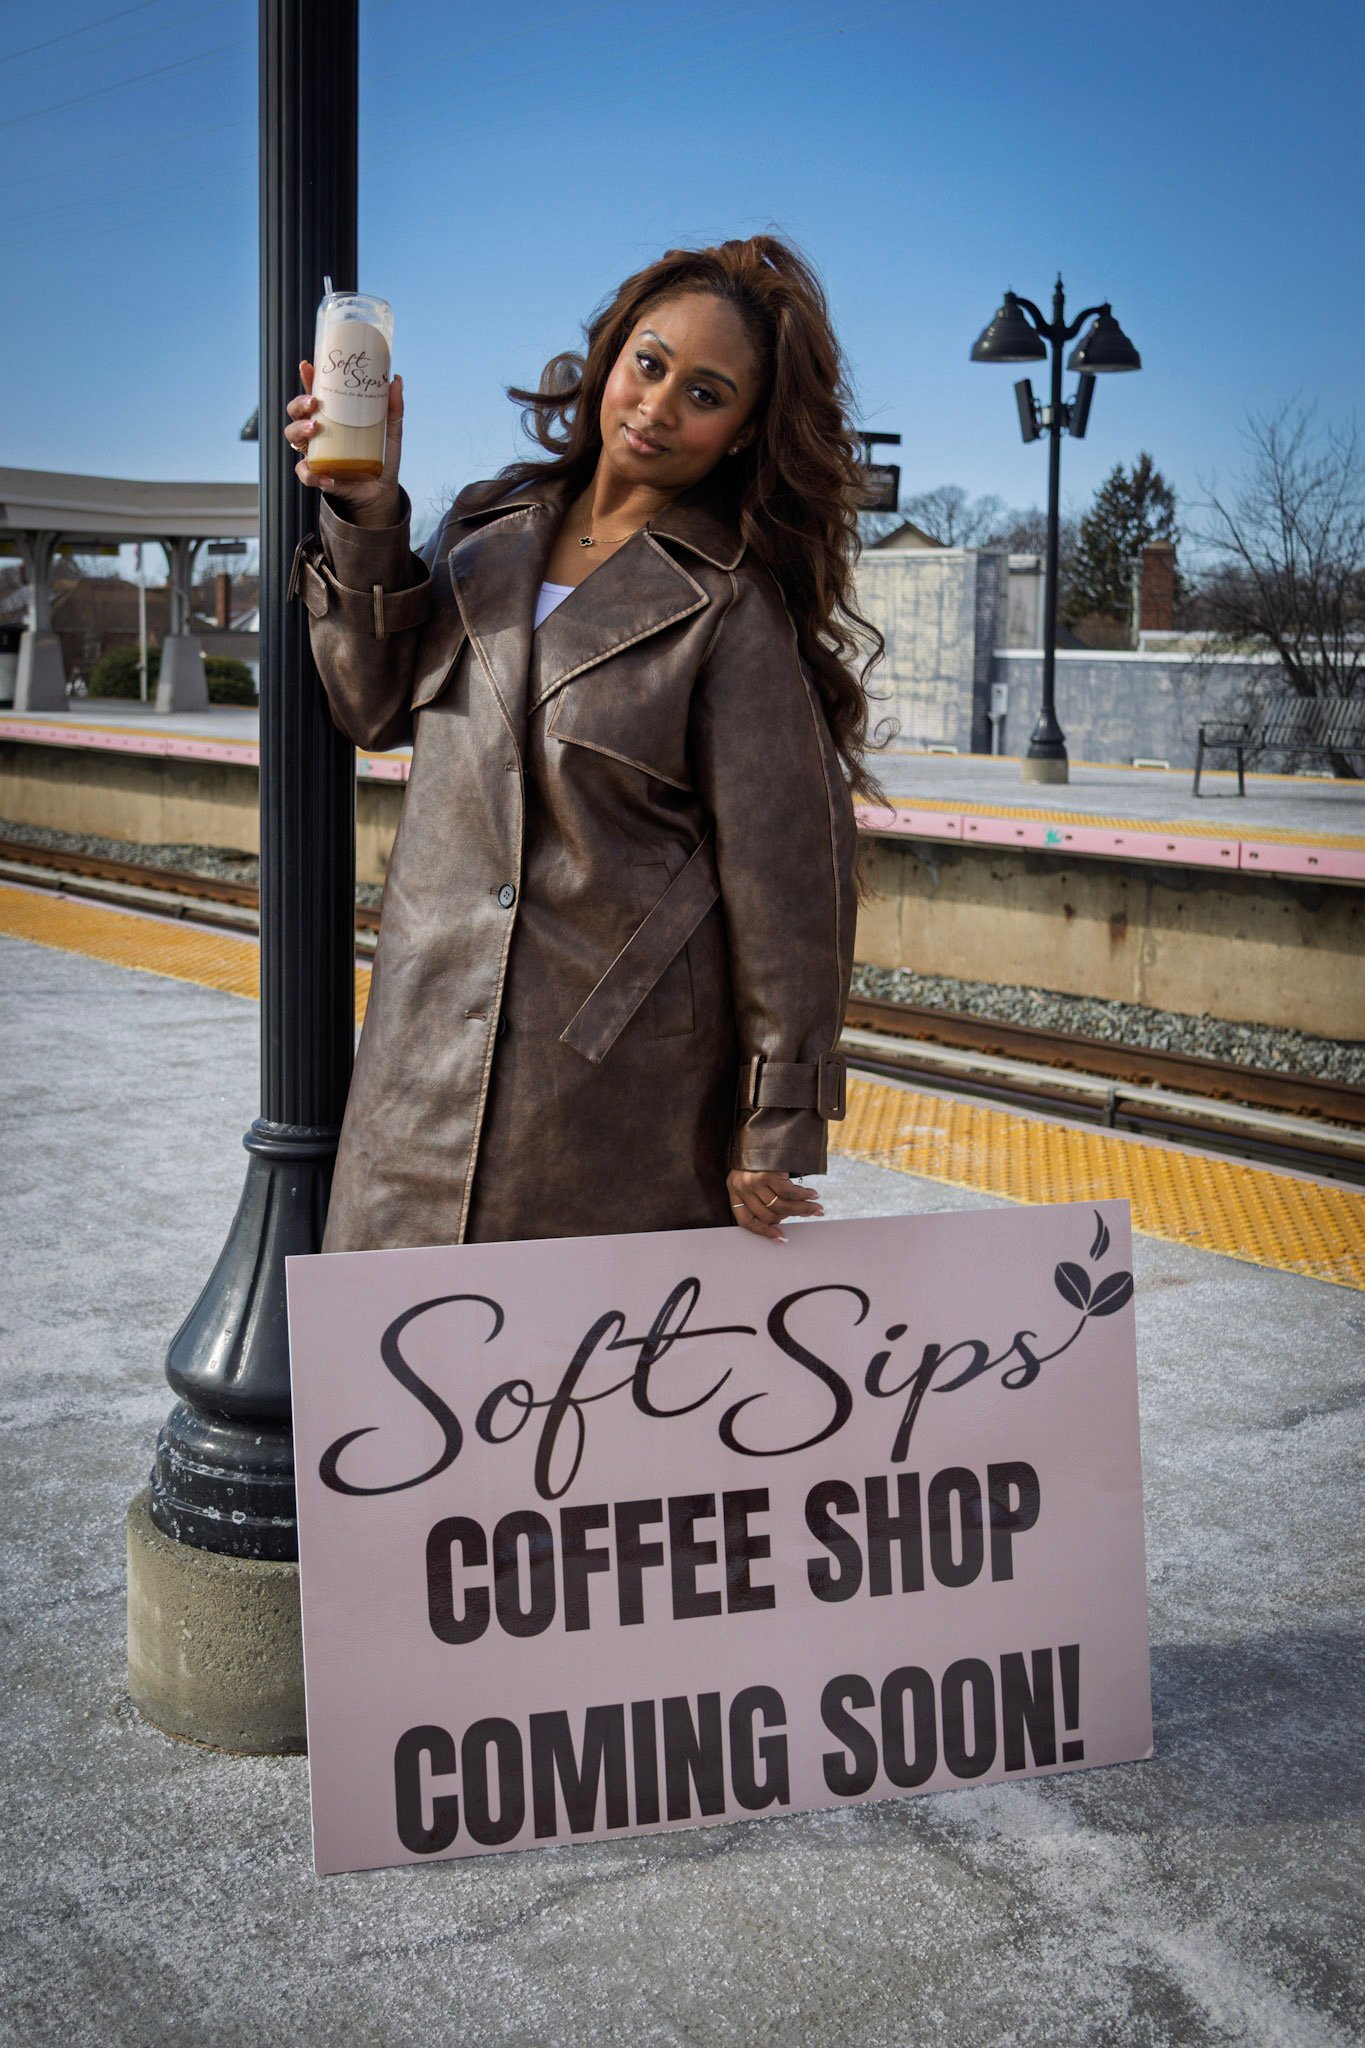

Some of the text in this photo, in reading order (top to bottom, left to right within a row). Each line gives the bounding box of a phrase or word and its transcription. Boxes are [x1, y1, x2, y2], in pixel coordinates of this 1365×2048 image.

[322, 349, 371, 376] Soft
[344, 368, 384, 392] Sips
[318, 1276, 1060, 1501] Soft Sips
[425, 1461, 1041, 1645] COFFEE SHOP
[393, 1643, 1085, 1855] COMING SOON!
